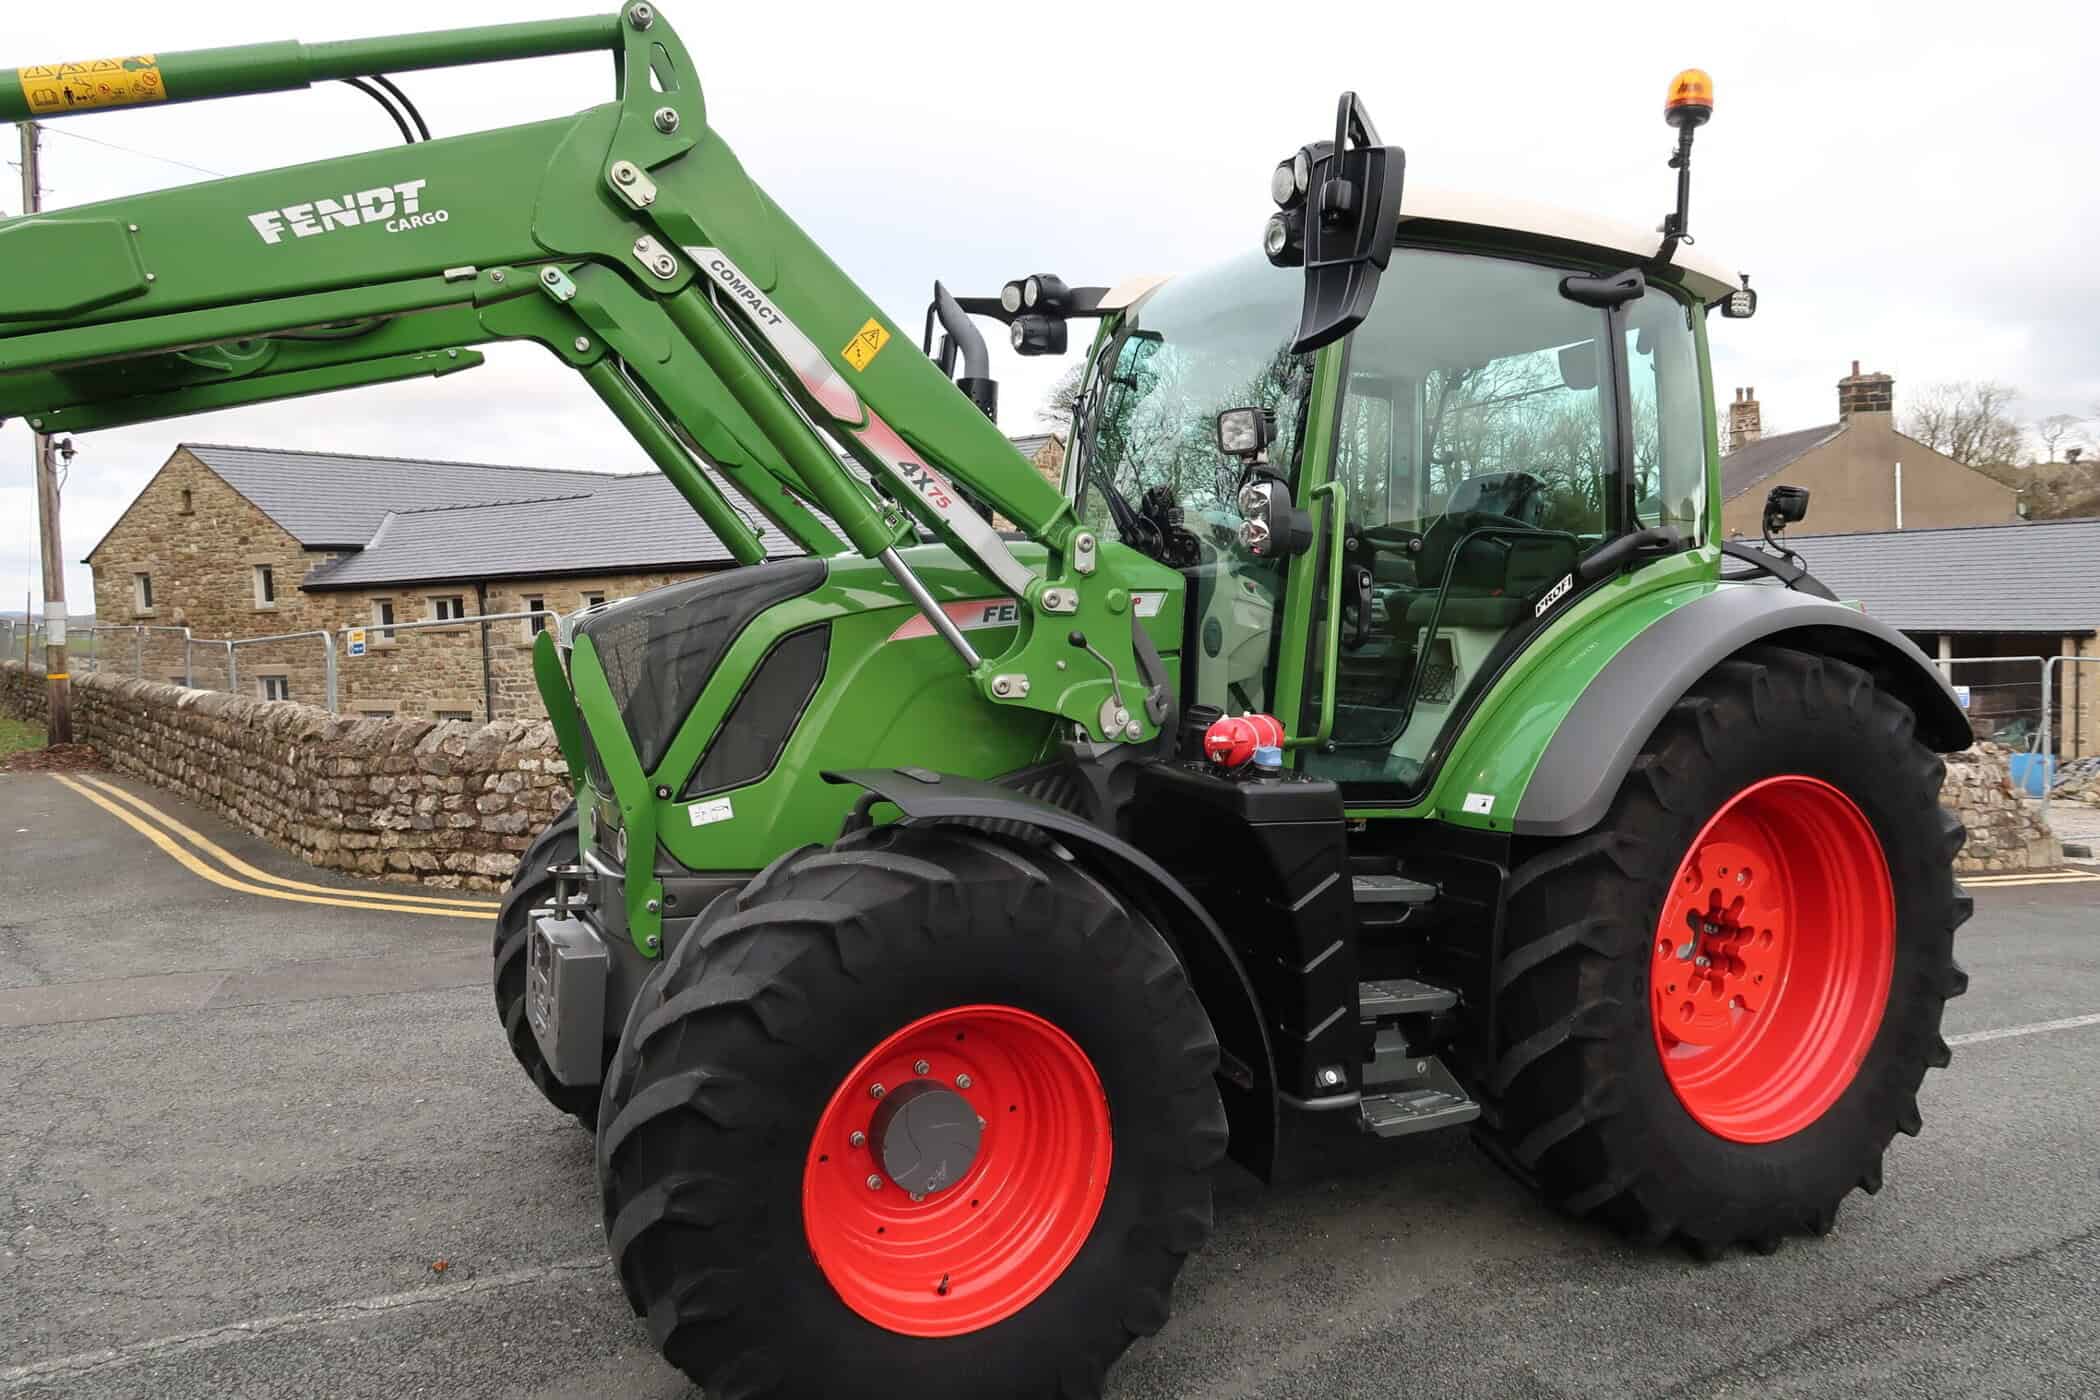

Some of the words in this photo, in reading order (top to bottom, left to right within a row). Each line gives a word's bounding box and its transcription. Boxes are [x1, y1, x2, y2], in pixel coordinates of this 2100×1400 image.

[248, 180, 426, 244] FENDT
[385, 210, 449, 232] CARGO
[711, 260, 782, 325] COMPACT
[898, 462, 952, 509] 4X75
[1537, 575, 1571, 613] PROFI
